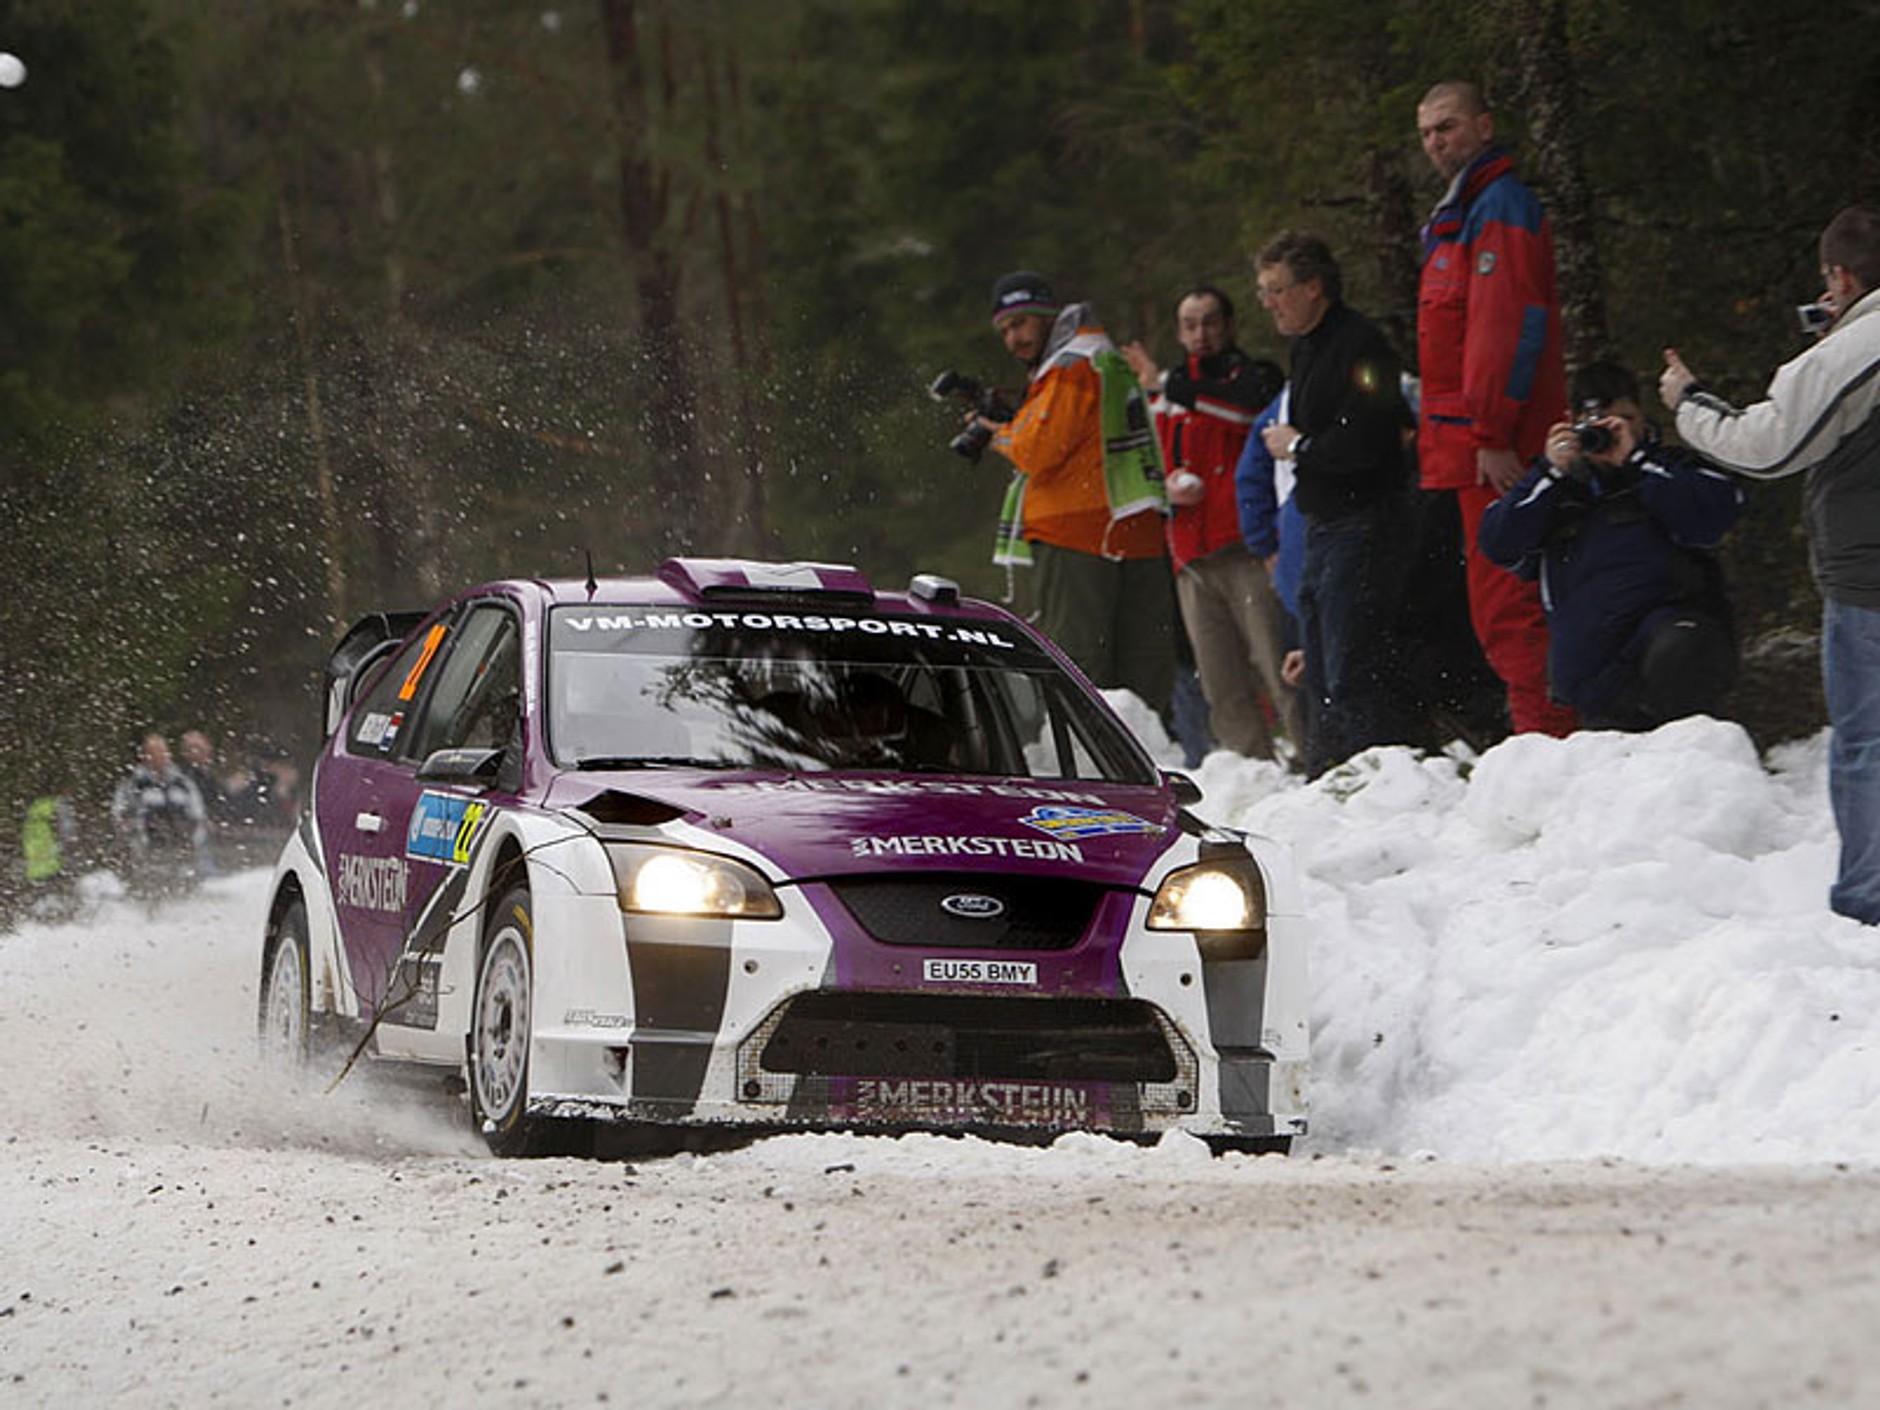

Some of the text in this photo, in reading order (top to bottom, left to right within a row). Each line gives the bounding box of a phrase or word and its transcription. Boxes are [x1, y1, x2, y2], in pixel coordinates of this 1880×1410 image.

[563, 612, 1015, 649] VM-MOTORSPORT.NL
[930, 962, 1031, 981] EU55 BMY
